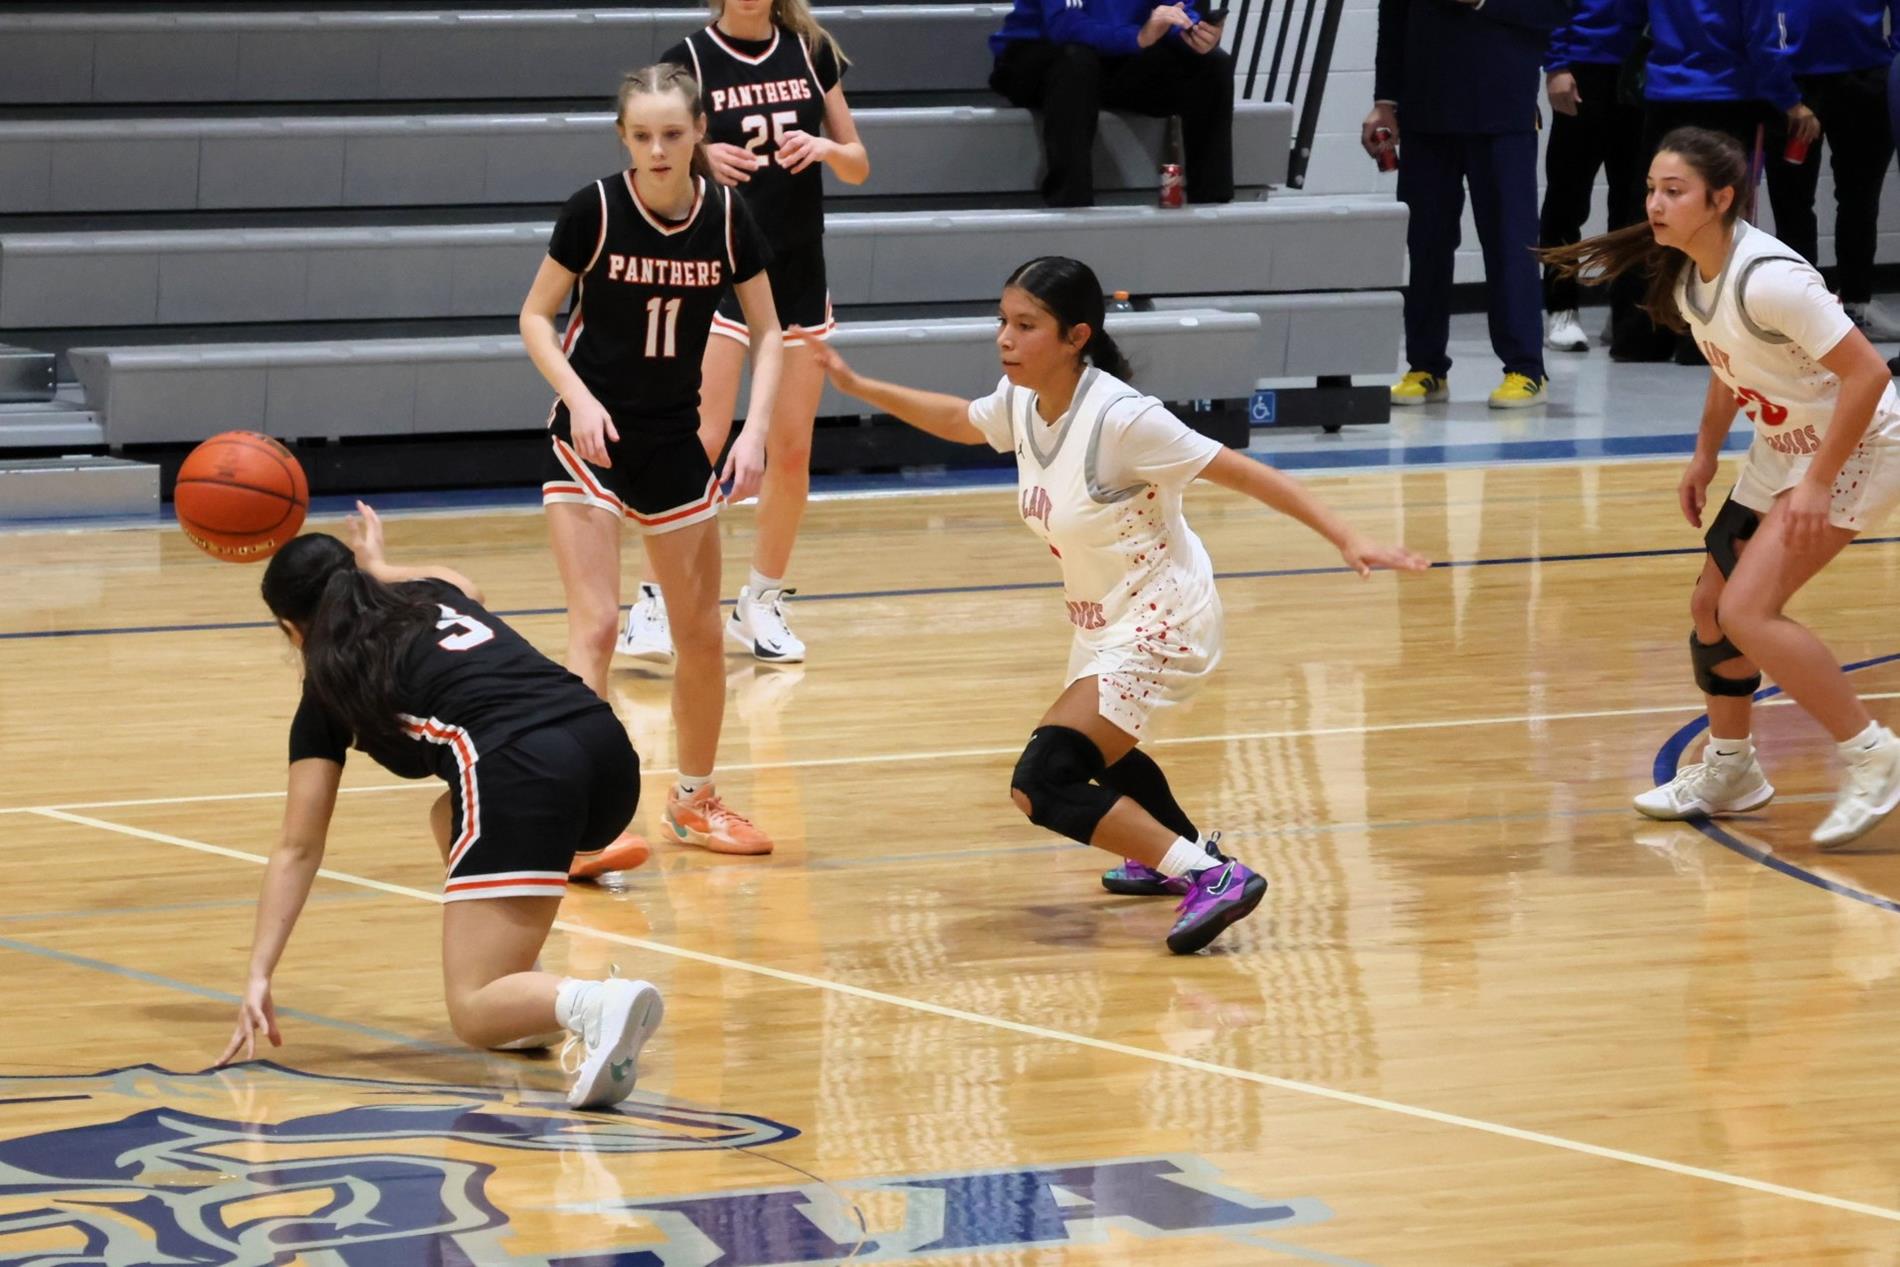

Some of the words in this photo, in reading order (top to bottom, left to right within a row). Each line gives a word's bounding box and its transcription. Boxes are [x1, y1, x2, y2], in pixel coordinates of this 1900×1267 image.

[711, 79, 811, 112] PANTHERS
[741, 110, 798, 167] 25
[608, 254, 722, 287] PANTHERS
[644, 297, 682, 358] 11
